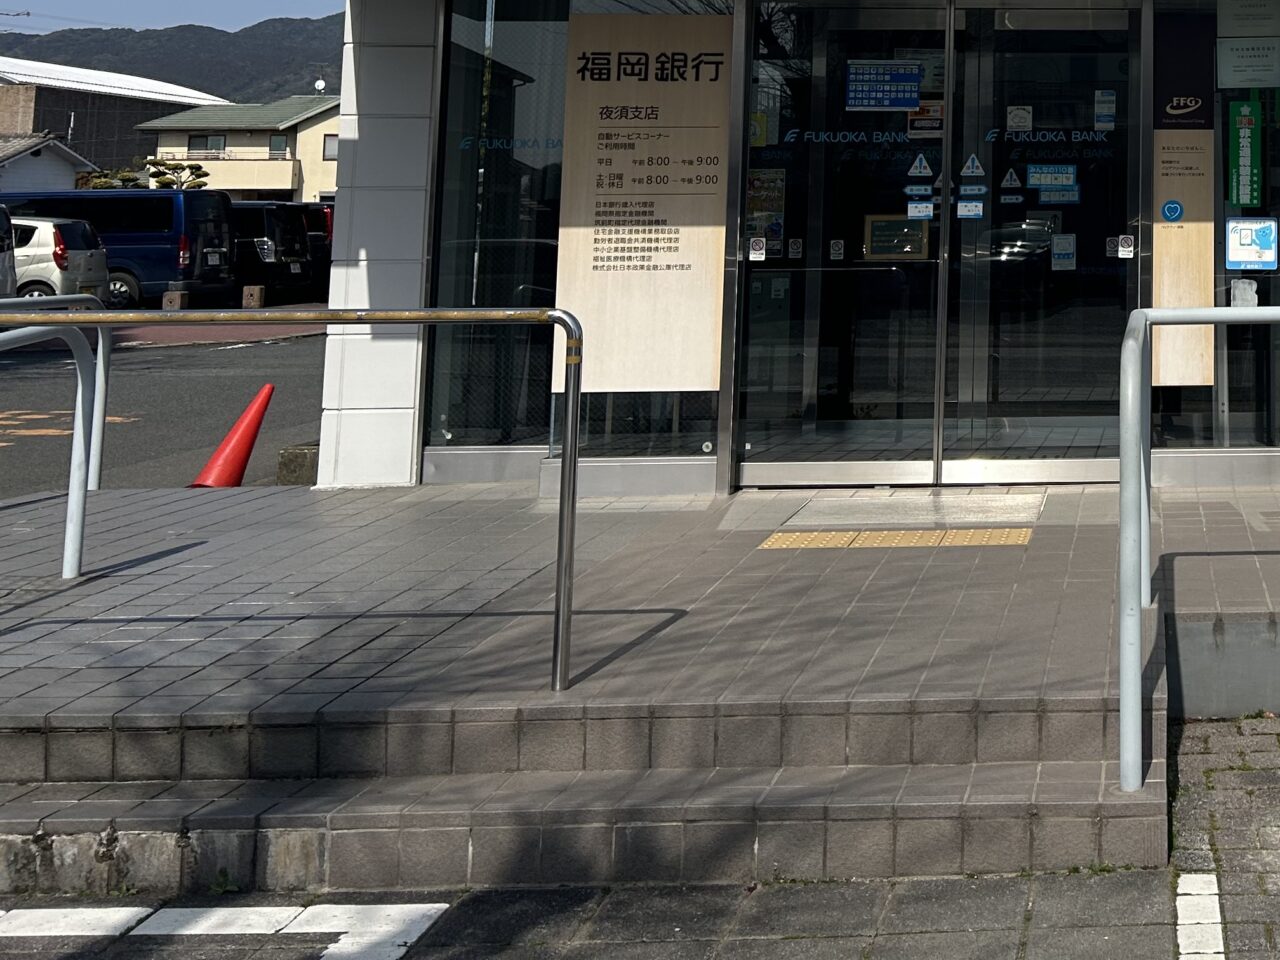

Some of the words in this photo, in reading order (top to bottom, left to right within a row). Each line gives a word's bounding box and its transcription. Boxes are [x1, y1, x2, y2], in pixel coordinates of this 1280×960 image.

[576, 51, 724, 82] 福岡銀行
[1172, 96, 1196, 107] FFG
[599, 105, 660, 120] 夜須支店
[597, 132, 670, 141] 自動サービスコーナー
[803, 131, 868, 142] FUKUOKA
[872, 131, 910, 142] BANK
[1004, 131, 1069, 142] FUKUOKA
[1071, 131, 1108, 142] BANK
[545, 138, 563, 149] BA
[597, 142, 636, 151] ご利用時間
[597, 158, 612, 166] 平日
